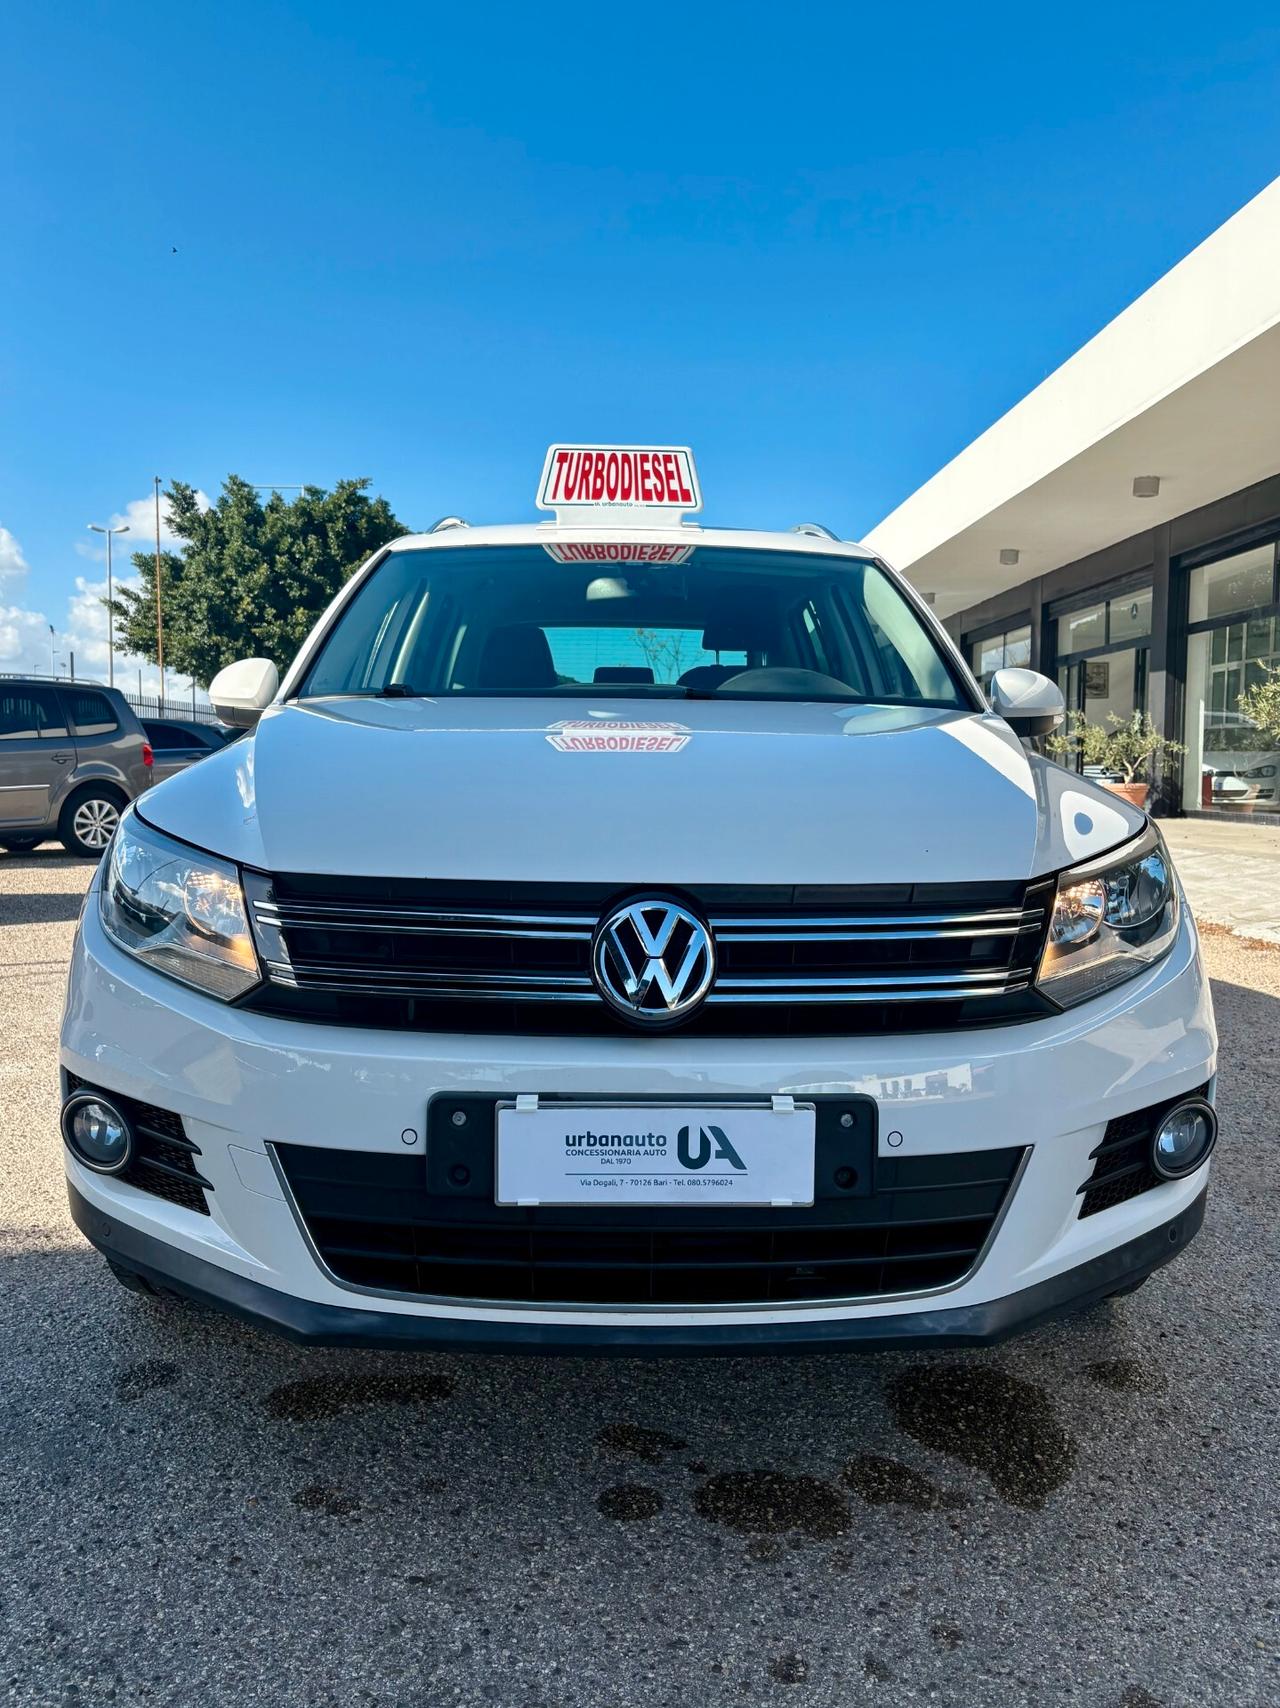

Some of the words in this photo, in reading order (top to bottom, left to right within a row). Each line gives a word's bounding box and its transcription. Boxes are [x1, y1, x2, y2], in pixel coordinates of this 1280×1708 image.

[551, 452, 692, 502] TURBODIESEL
[601, 905, 706, 1010] VW
[565, 1131, 667, 1147] urbanauto
[677, 1125, 748, 1170] UA
[593, 1179, 618, 1188] Dogali,
